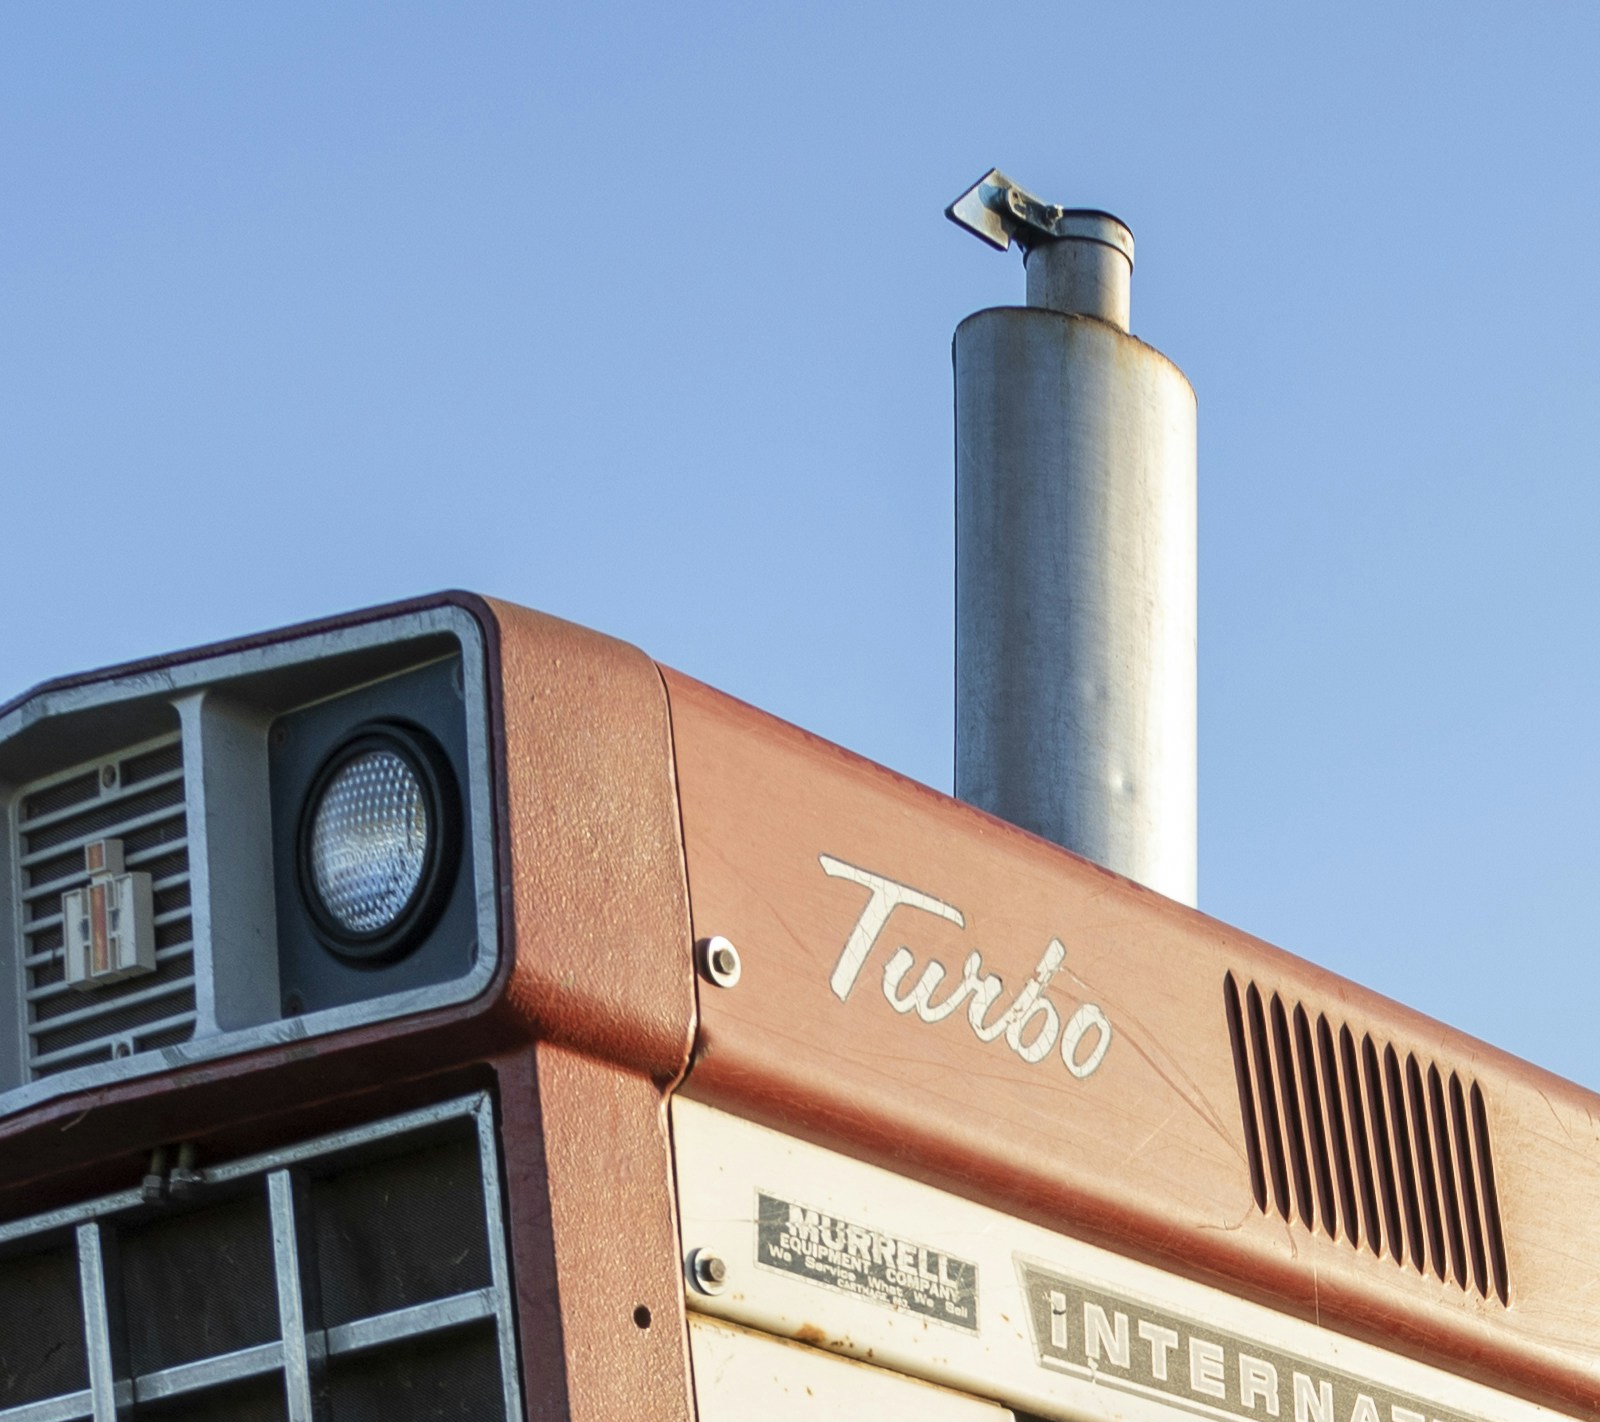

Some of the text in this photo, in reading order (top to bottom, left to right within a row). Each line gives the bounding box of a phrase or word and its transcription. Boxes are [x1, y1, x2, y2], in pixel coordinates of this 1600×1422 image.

[818, 852, 1112, 1080] Turbo
[769, 1243, 969, 1319] We Service What We Sell
[780, 1232, 961, 1303] EQUIPMENT COMPANY
[786, 1203, 959, 1289] MURRELL
